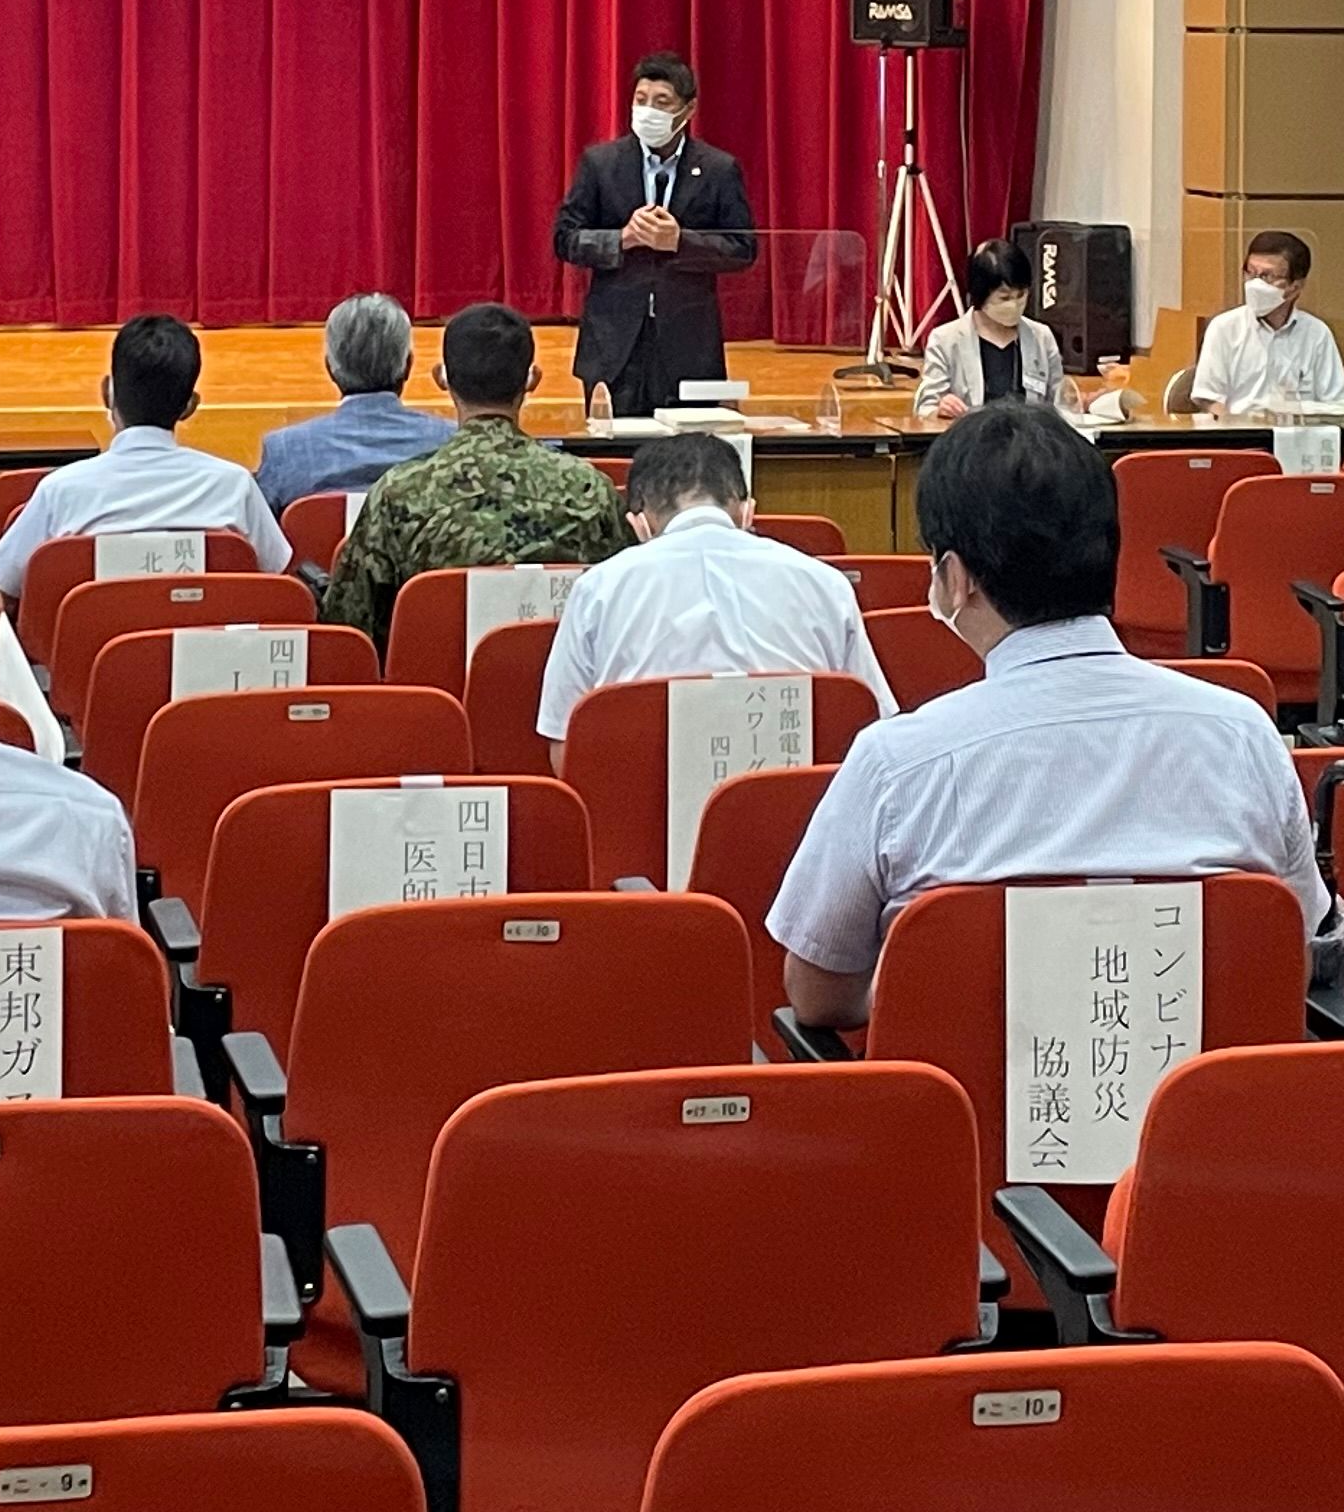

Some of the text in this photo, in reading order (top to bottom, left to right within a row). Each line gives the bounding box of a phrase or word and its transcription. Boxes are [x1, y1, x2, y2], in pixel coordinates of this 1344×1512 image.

[868, 2, 914, 21] RAMSA
[1043, 244, 1057, 310] RAMSA
[1090, 945, 1130, 1124] 地域防災
[1028, 1036, 1070, 1170] 協議会
